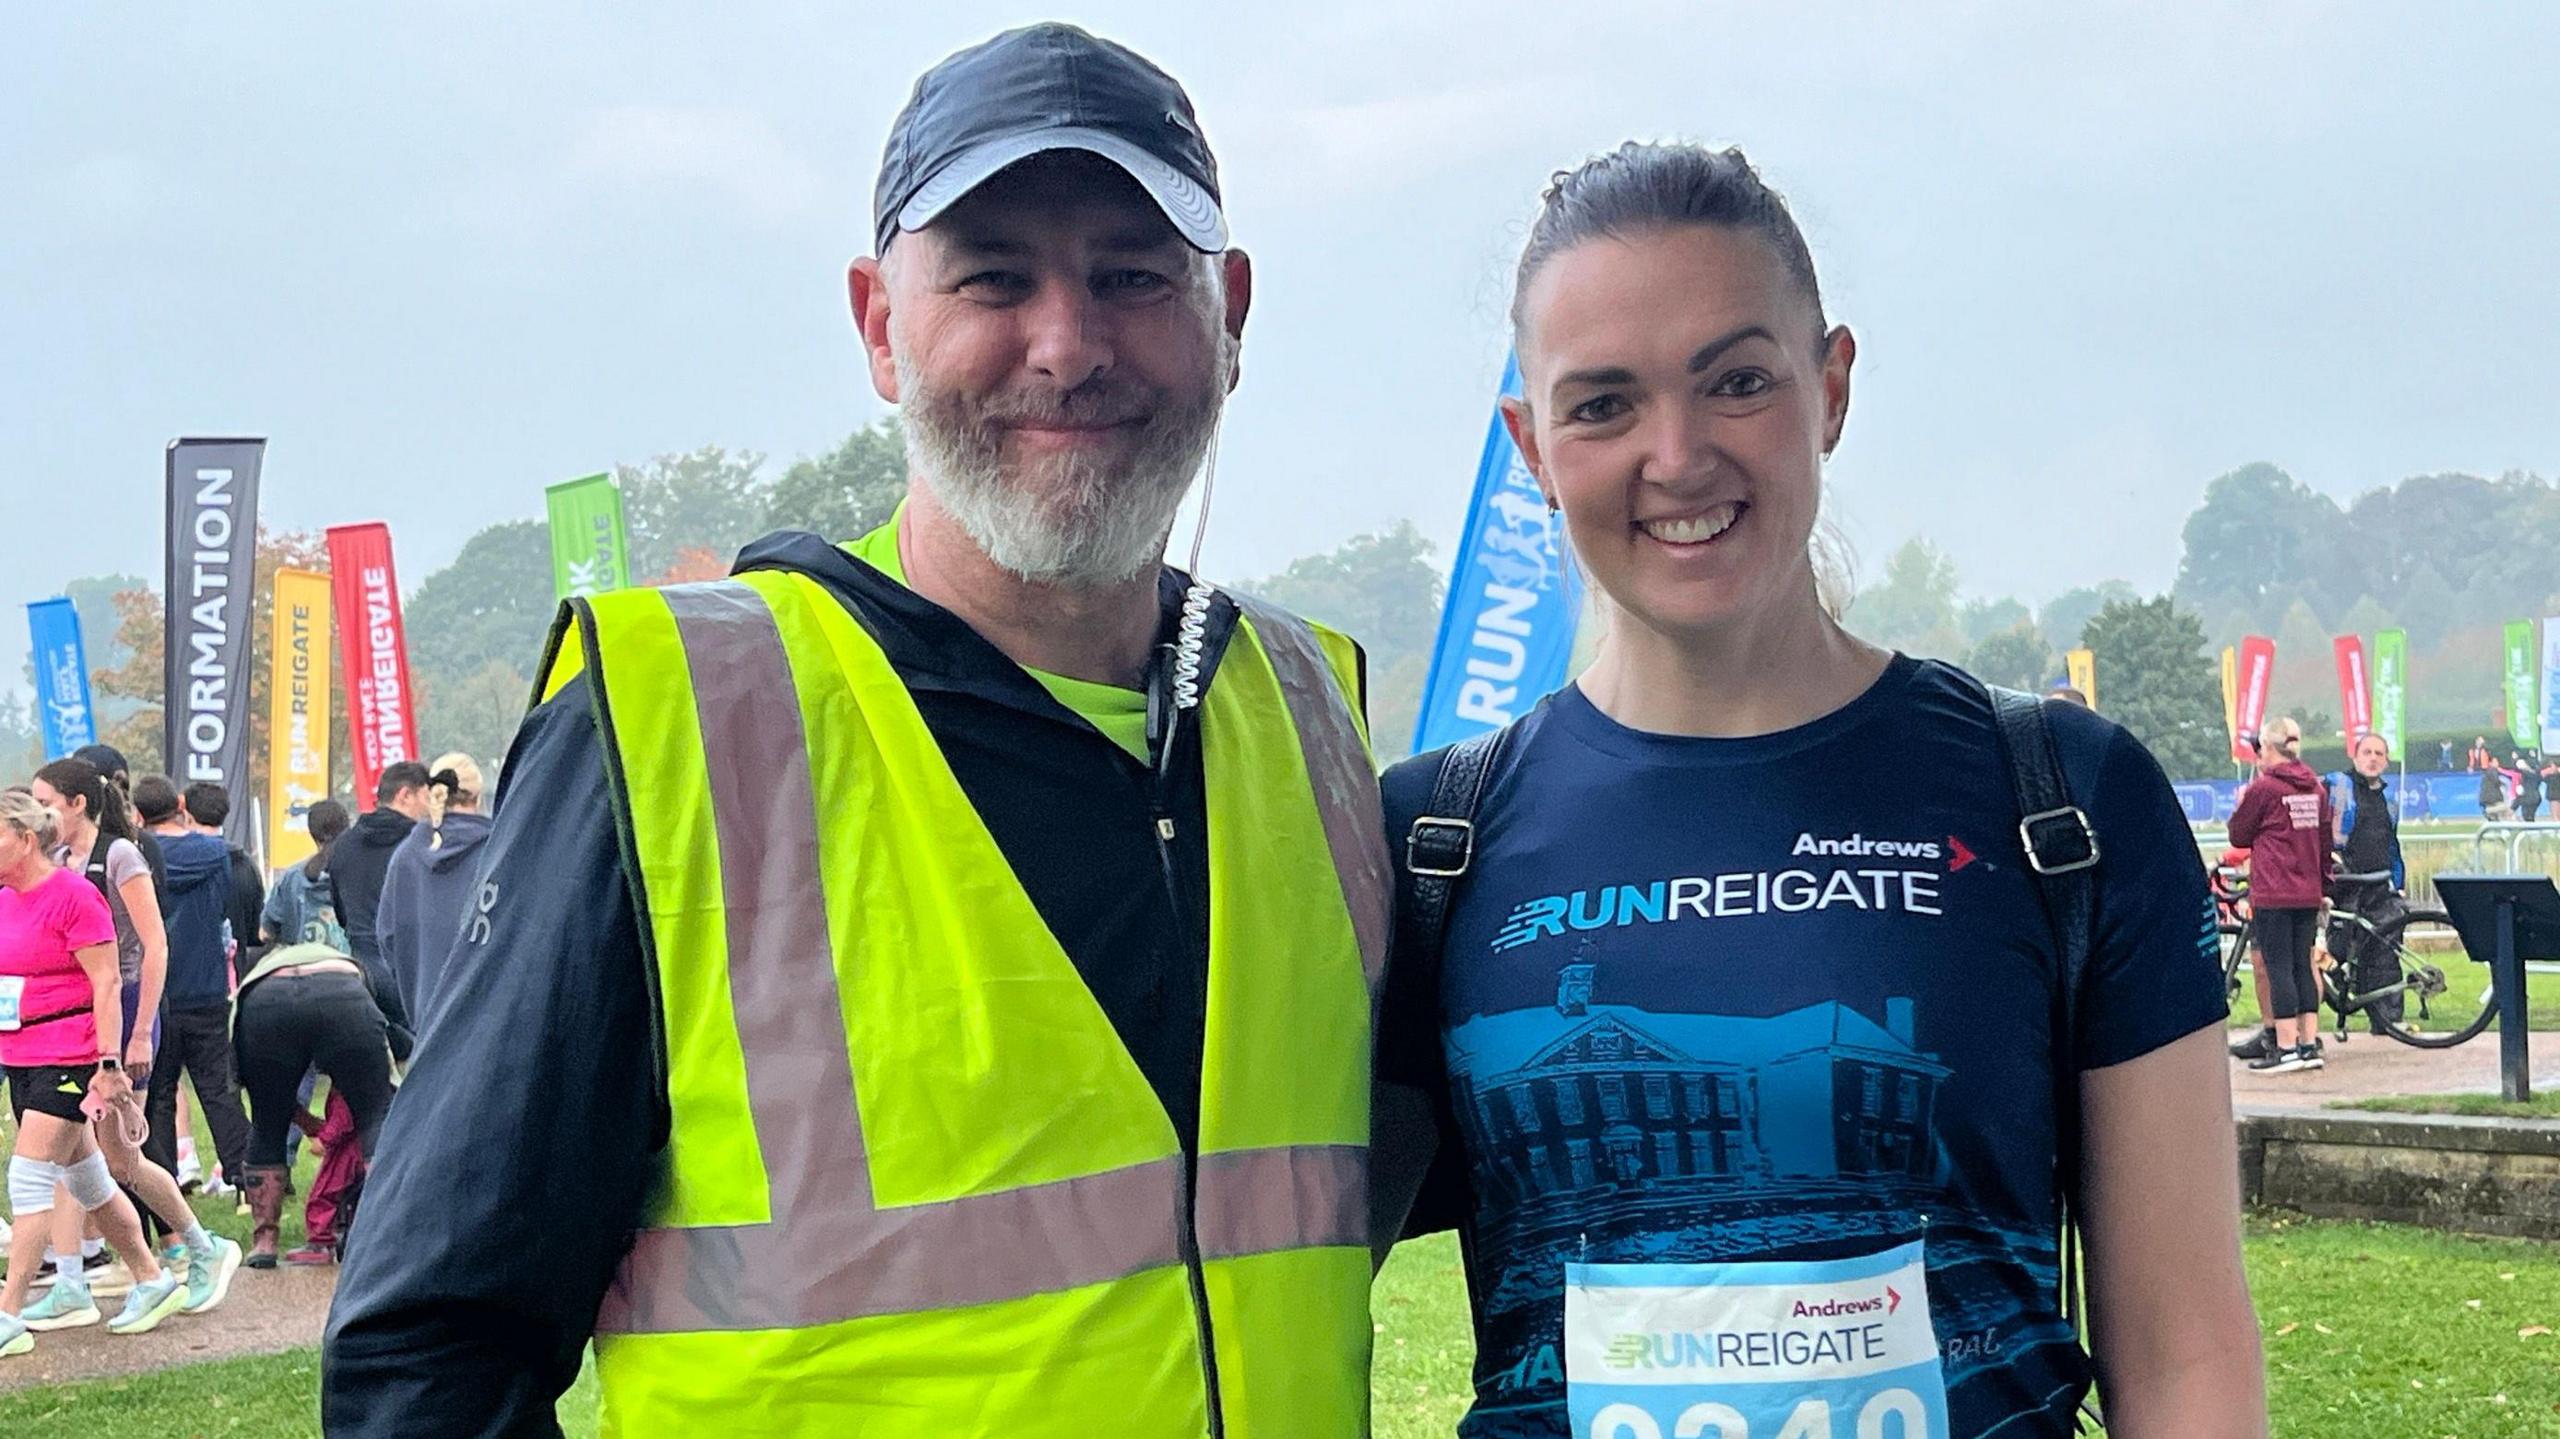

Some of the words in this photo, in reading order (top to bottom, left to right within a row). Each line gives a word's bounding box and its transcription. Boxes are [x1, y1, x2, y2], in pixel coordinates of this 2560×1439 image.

[187, 468, 233, 780] FORMATION
[1456, 582, 1539, 728] RUN
[289, 604, 310, 774] RUNREIGATE
[1791, 832, 1941, 860] Andrews
[1491, 868, 1943, 954] RUNREIGATE
[1603, 1323, 1886, 1370] RUNREIGATE
[1791, 1296, 1883, 1319] Andrews
